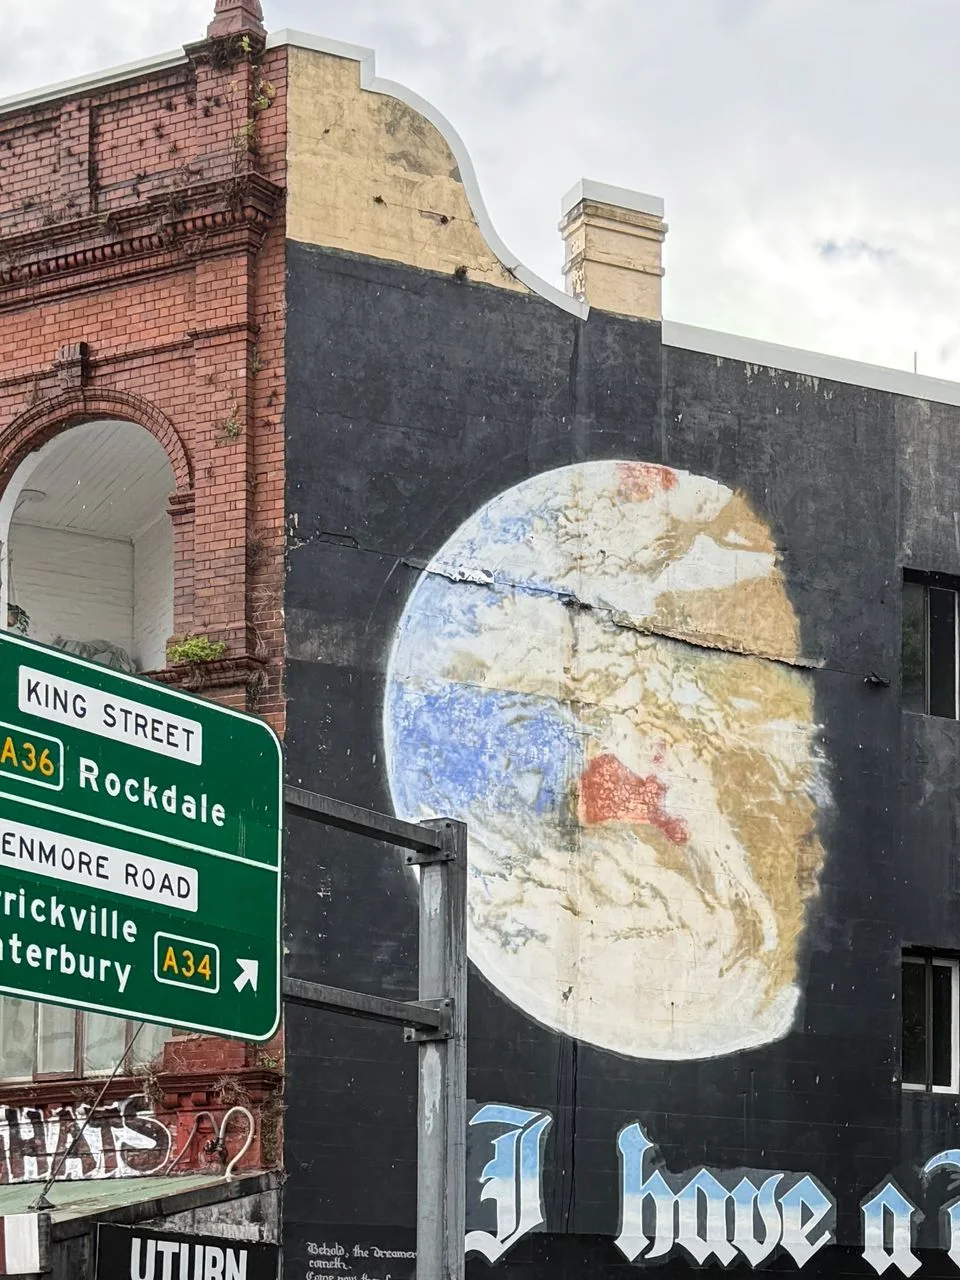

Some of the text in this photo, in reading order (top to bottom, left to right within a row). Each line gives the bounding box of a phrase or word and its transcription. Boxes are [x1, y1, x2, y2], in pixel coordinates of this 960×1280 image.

[26, 678, 195, 752] KING STREET
[0, 736, 55, 776] A36
[79, 757, 226, 827] Rockdale
[2, 832, 191, 900] ENMORE ROAD
[0, 886, 138, 943] rickville
[0, 930, 132, 993] terbury
[162, 946, 212, 981] A34
[0, 1093, 172, 1183] HATS
[465, 1104, 553, 1264] I
[614, 1122, 833, 1270] have
[861, 1182, 923, 1279] a
[353, 1244, 369, 1258] the
